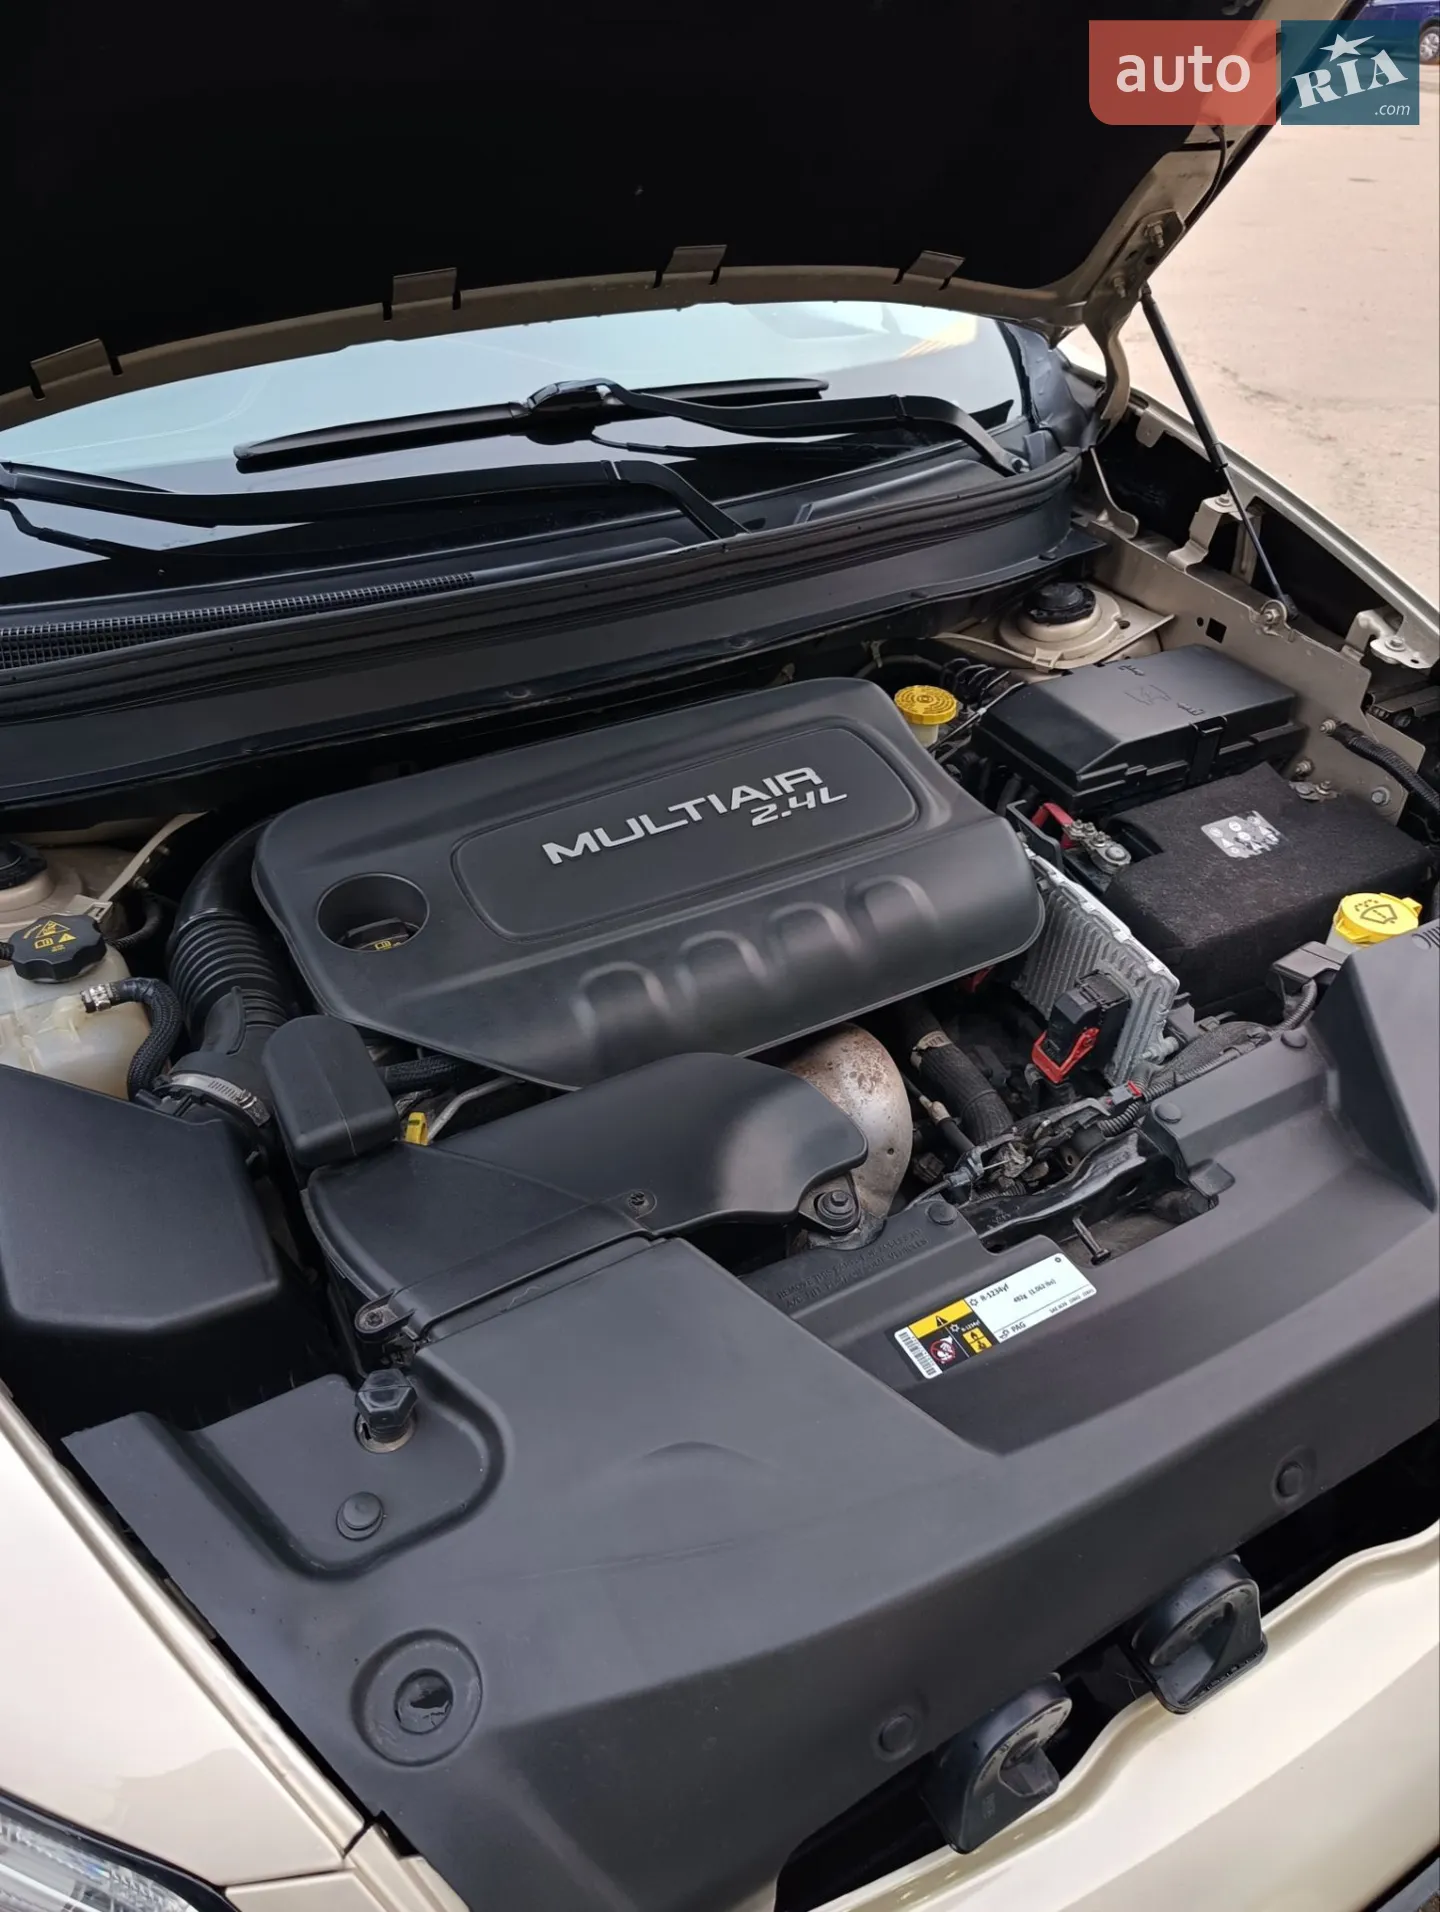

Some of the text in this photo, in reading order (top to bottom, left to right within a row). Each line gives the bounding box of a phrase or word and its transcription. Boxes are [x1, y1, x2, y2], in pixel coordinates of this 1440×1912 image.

[542, 767, 823, 864] MULTIAIR
[750, 786, 848, 826] 2.4L
[1011, 1321, 1026, 1334] PAG
